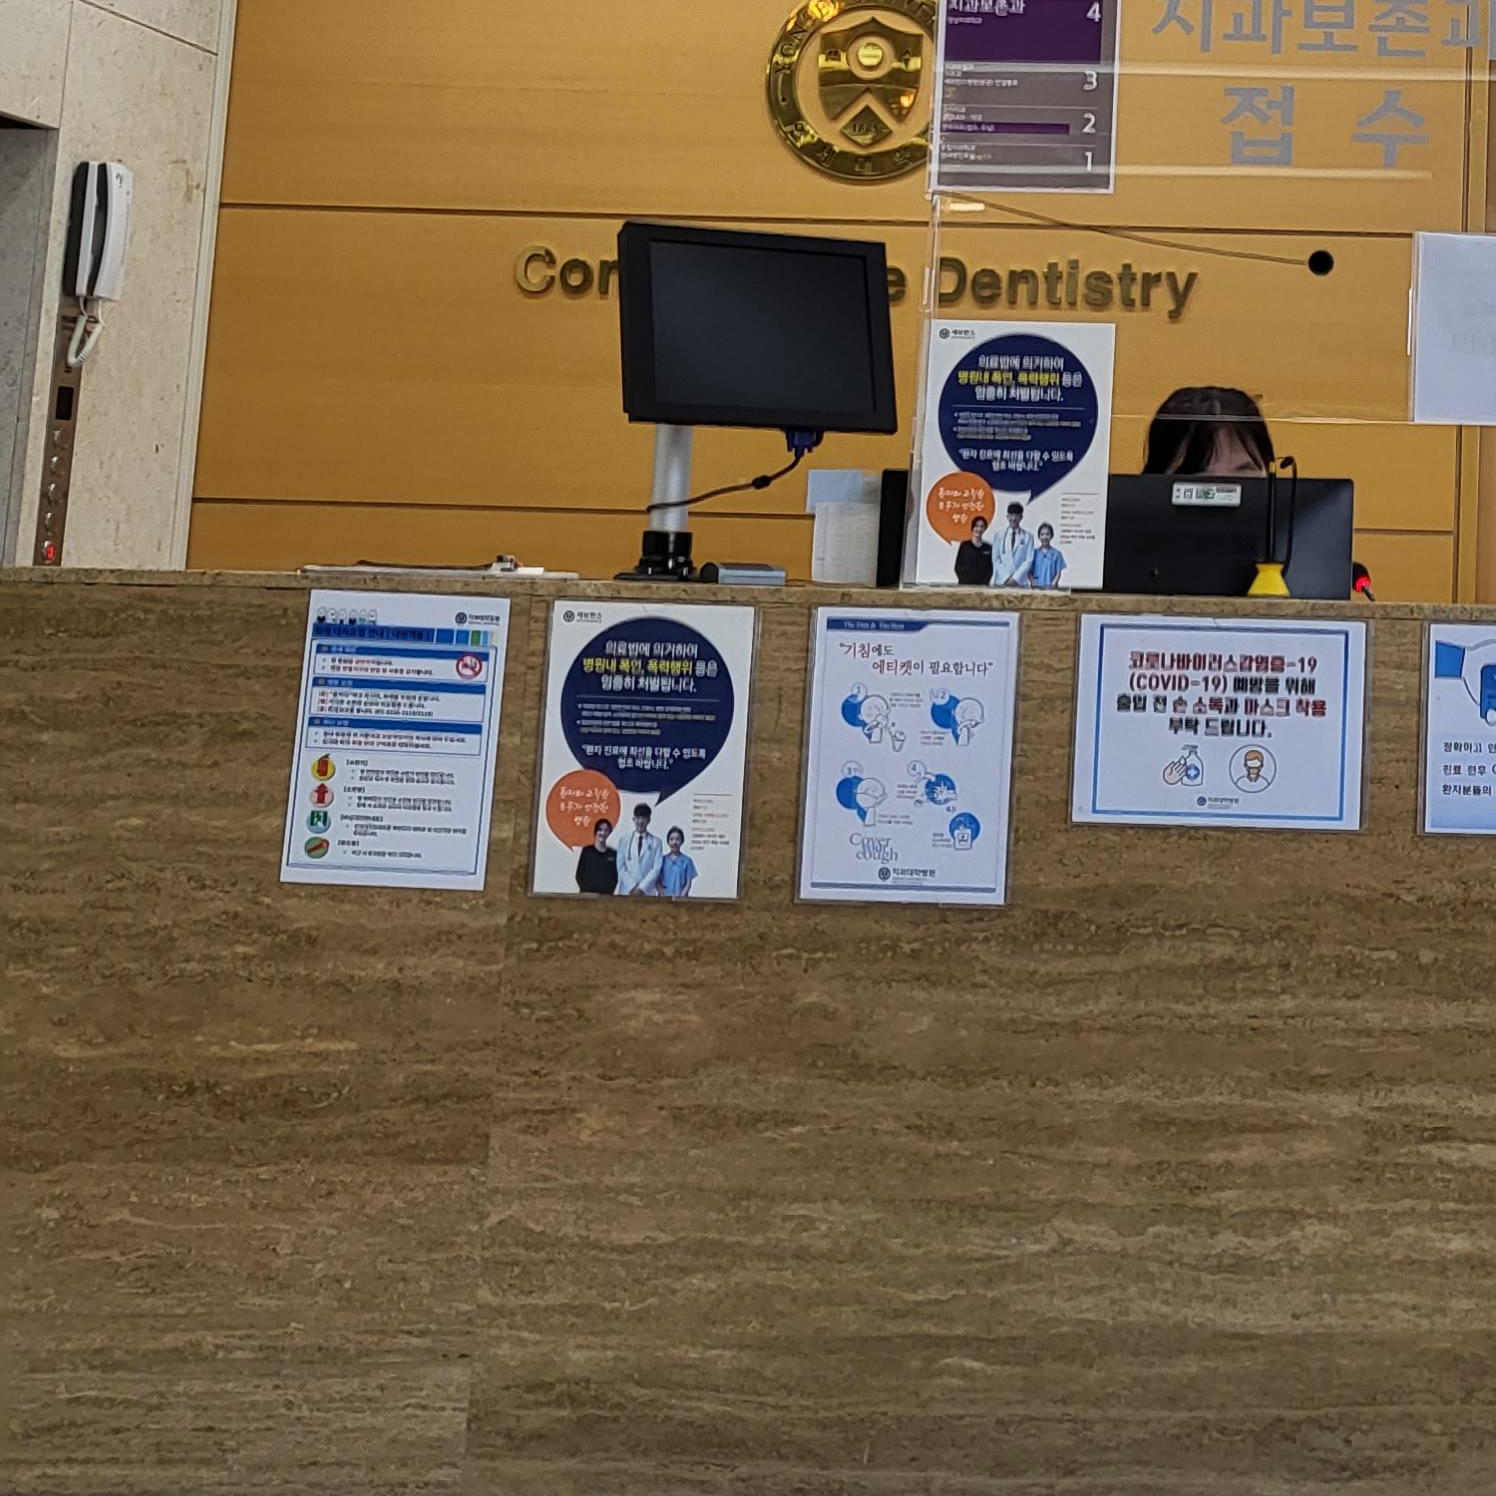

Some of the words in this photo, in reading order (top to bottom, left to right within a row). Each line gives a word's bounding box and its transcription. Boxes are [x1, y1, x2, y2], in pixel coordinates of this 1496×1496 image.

[1086, 1, 1101, 22] 4
[1083, 71, 1097, 91] 3
[1082, 113, 1096, 134] 2
[1084, 152, 1093, 171] 1
[936, 254, 1197, 319] Dentistry
[605, 640, 651, 657] 의료법에
[583, 658, 616, 674] 병원내
[647, 659, 693, 676] 폭력행위
[872, 659, 924, 676] 에티켓이
[1128, 651, 1317, 673] 코로나바이러스감염증-19
[1129, 673, 1228, 694] (COVID-19)
[1233, 676, 1280, 694] 예방을
[1285, 677, 1315, 695] 위해
[1116, 694, 1147, 713] 출입
[1153, 695, 1167, 713] 전
[1172, 696, 1187, 714] 손
[1192, 696, 1239, 715] 소독과
[1244, 698, 1291, 717] 마스크
[1295, 698, 1327, 718] 착용
[1169, 717, 1199, 735] 부탁
[1204, 718, 1272, 738] 드립니다.
[673, 747, 681, 758] 수
[1443, 764, 1461, 776] 진료
[1442, 784, 1492, 796] 환자분들의
